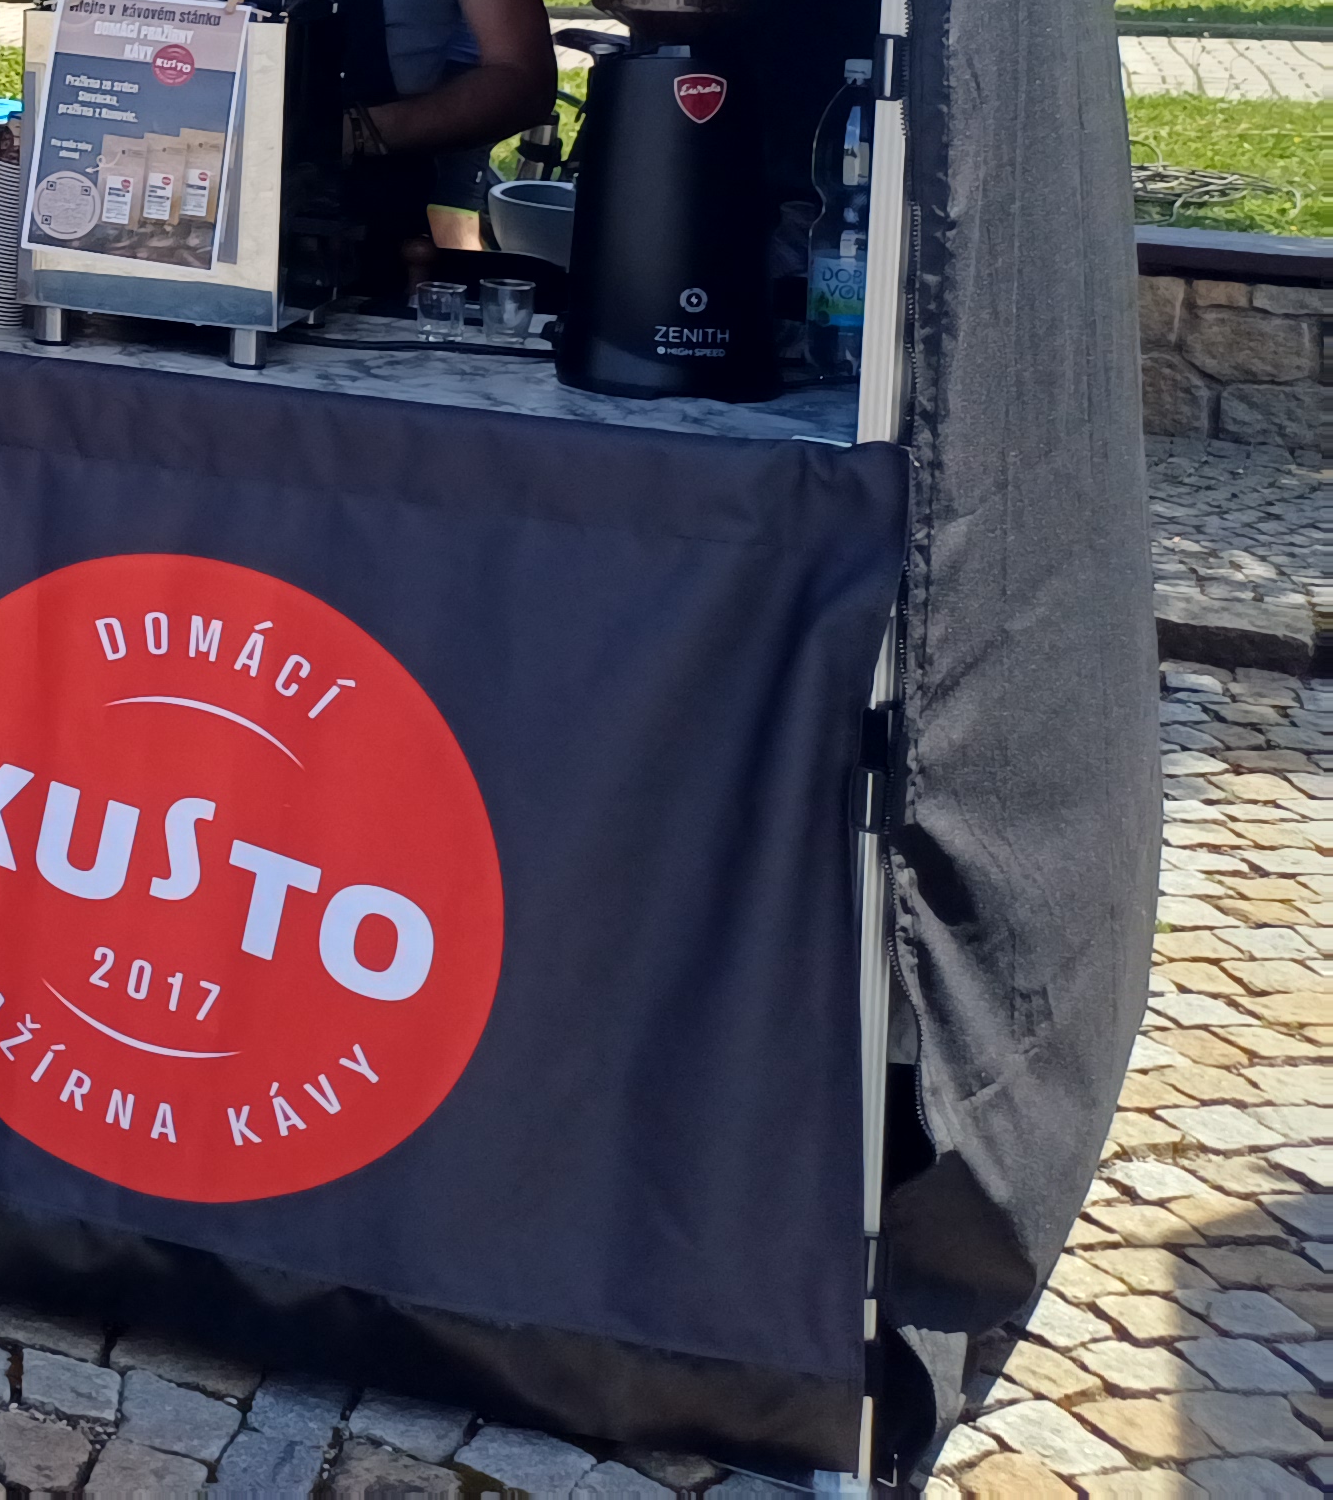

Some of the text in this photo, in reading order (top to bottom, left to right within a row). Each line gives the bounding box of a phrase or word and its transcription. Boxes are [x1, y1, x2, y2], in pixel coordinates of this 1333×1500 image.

[121, 3, 176, 22] kávovém
[178, 10, 222, 27] stánku
[94, 19, 139, 38] DOMÁCÍ
[123, 42, 154, 61] KÁVY
[822, 266, 864, 285] DOB
[825, 283, 866, 301] VOD
[654, 325, 730, 343] ZENITH
[95, 611, 356, 719] DOMÁCÍ
[89, 947, 221, 1021] 2017
[227, 1043, 379, 1146] KÁVY
